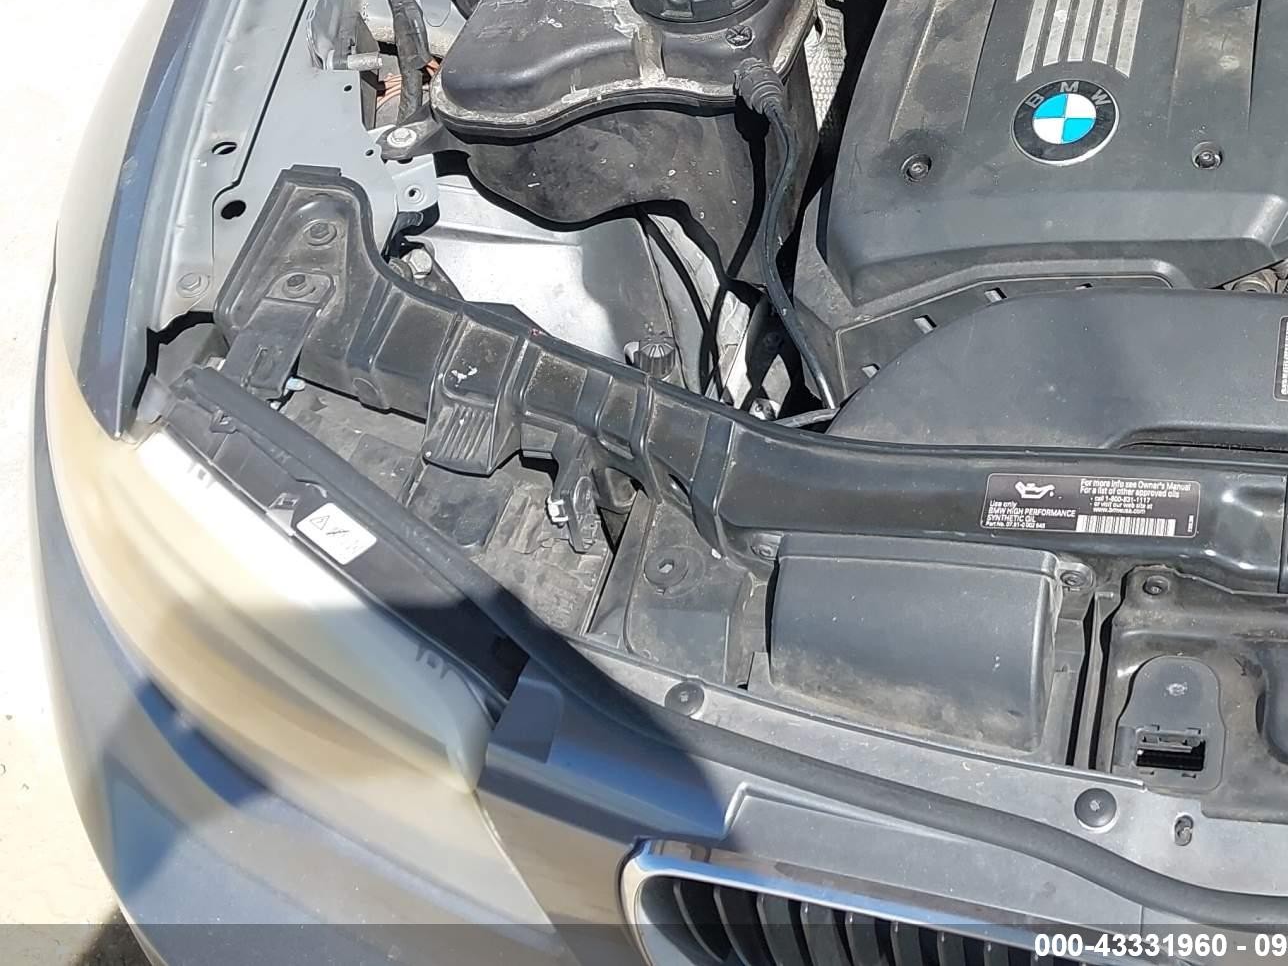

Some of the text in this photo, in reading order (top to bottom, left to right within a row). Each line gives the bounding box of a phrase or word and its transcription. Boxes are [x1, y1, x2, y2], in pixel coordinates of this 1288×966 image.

[1025, 81, 1112, 109] BMW
[1080, 478, 1092, 487] For
[1092, 480, 1110, 488] more
[1137, 481, 1165, 490] Owner's
[1166, 481, 1191, 491] Manual
[1080, 486, 1091, 494] For
[1097, 487, 1108, 495] list
[1116, 488, 1134, 496] other
[1135, 489, 1167, 498] approved
[1168, 490, 1180, 499] oils
[989, 499, 1018, 509] Use only
[988, 506, 1076, 518] BMW HIGH PERFORMANCE
[986, 514, 1037, 523] SYNTHETIC OIL
